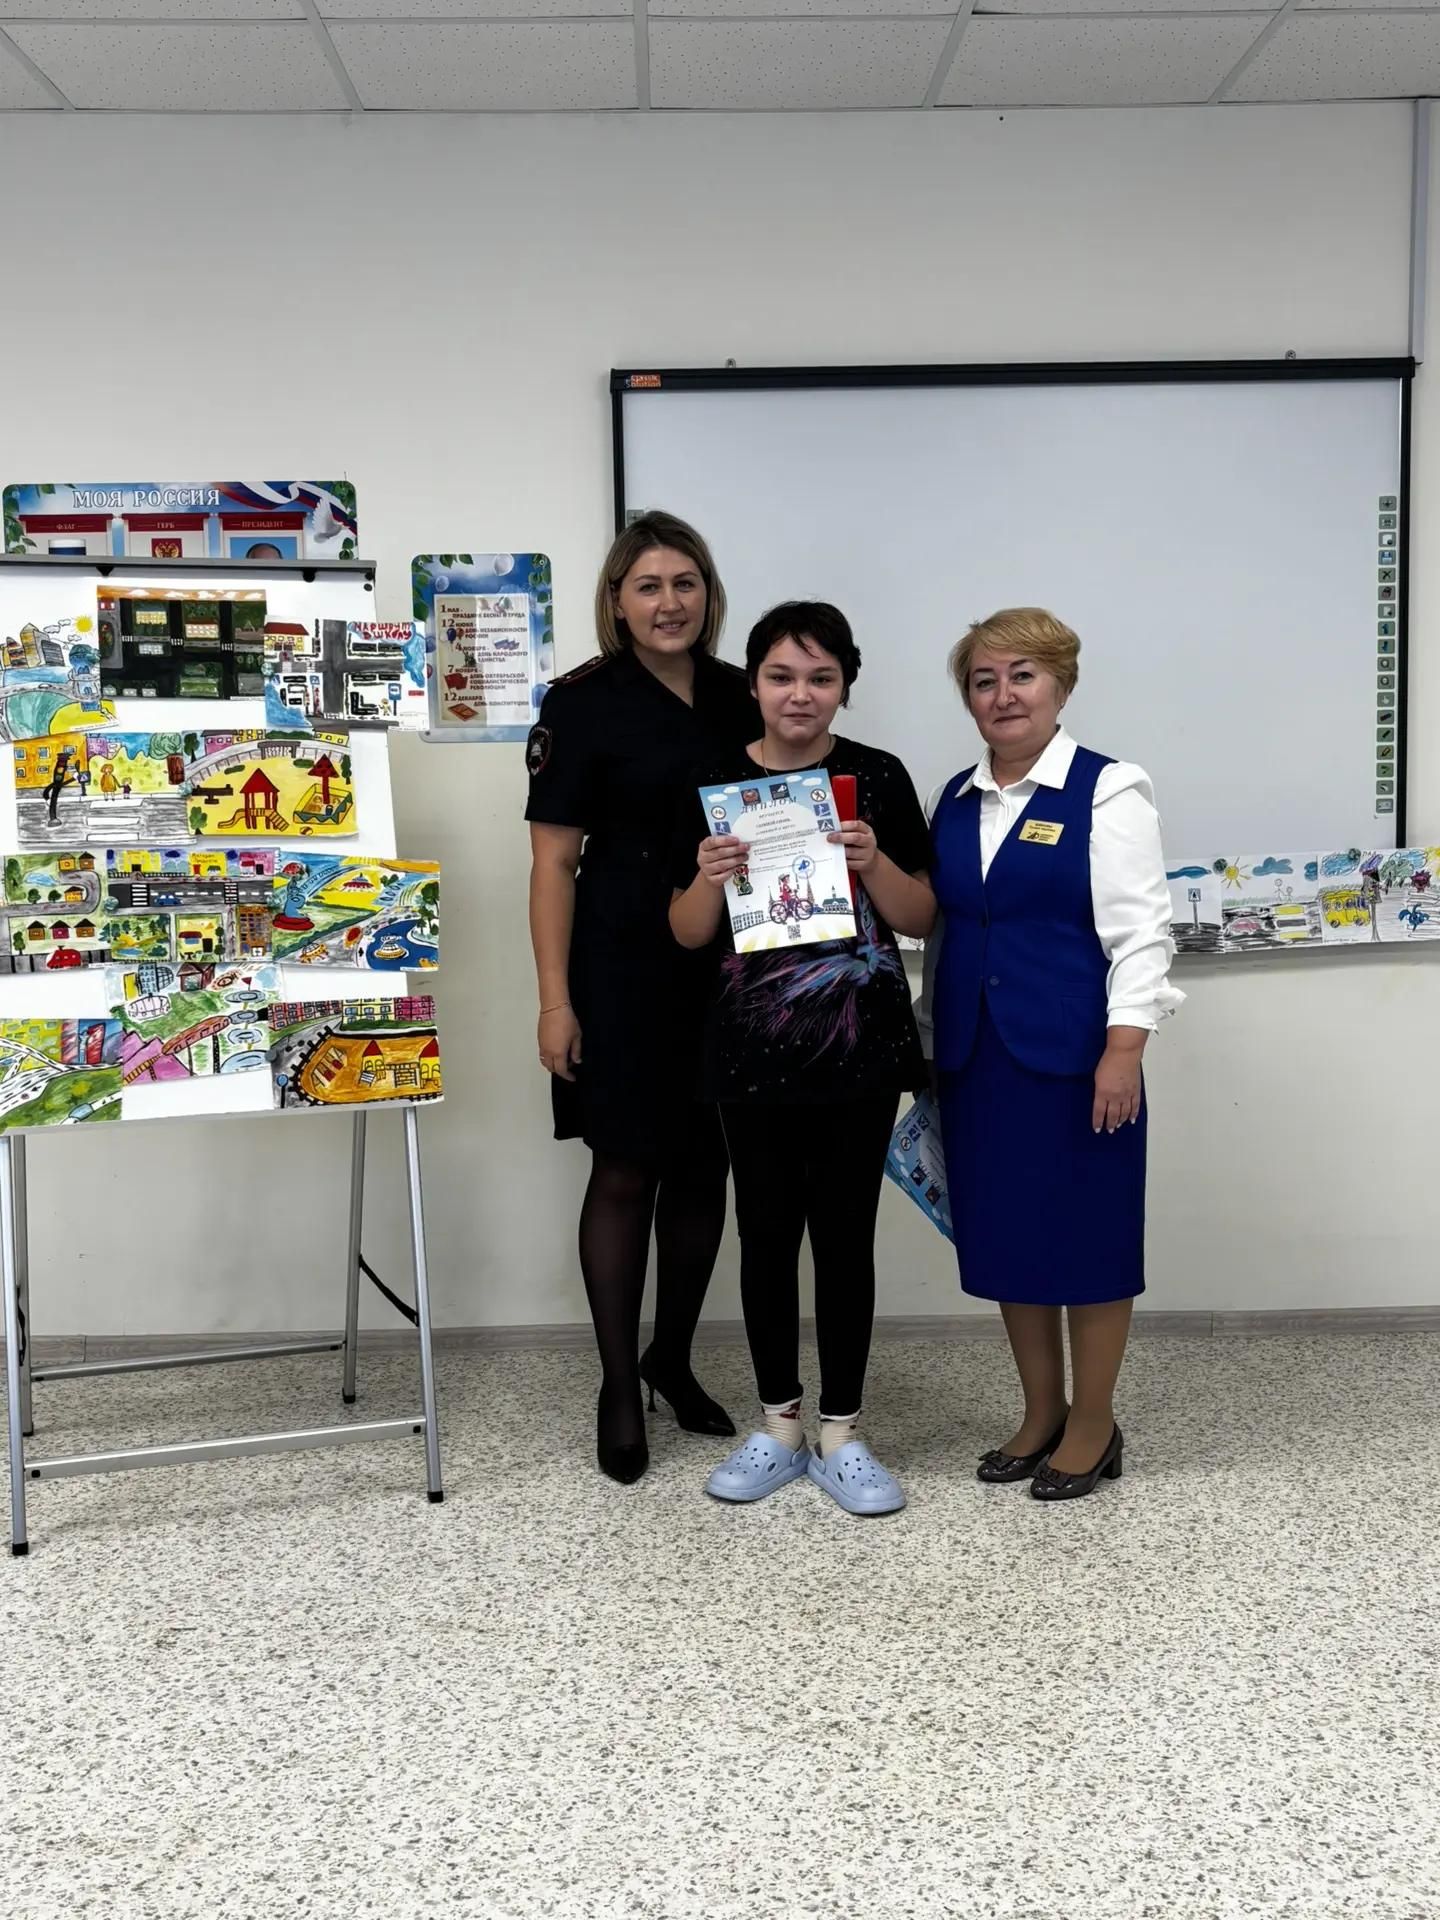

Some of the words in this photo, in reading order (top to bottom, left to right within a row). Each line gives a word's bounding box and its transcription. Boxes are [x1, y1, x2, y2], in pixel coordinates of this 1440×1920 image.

[73, 489, 123, 508] МОЯ
[133, 488, 221, 507] РОССИЯ
[242, 520, 284, 528] ПРЕЗИДЕНТ
[442, 619, 455, 627] 12
[444, 692, 457, 701] 12
[740, 797, 797, 814] ДИПЛОМ
